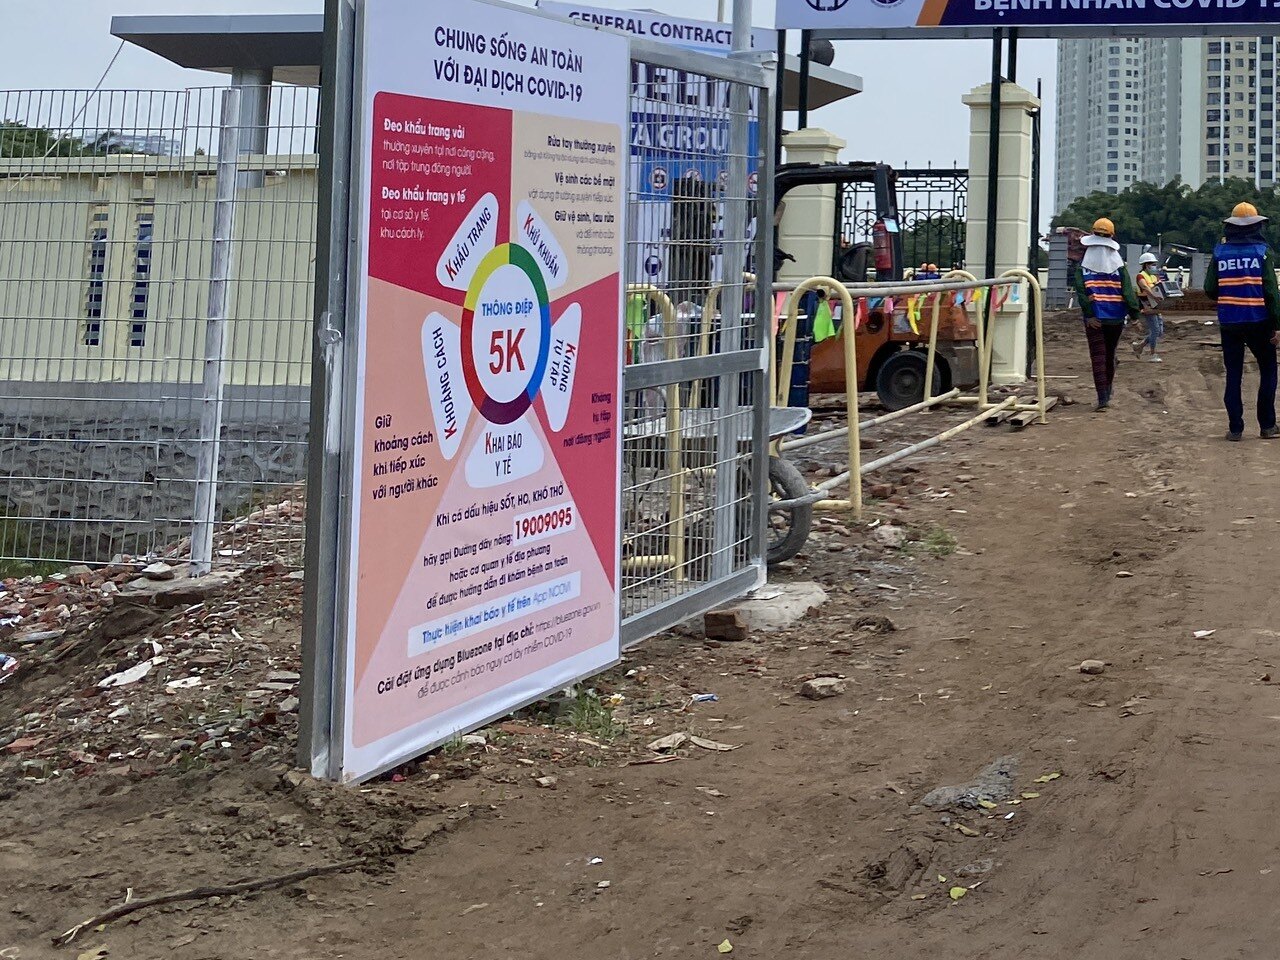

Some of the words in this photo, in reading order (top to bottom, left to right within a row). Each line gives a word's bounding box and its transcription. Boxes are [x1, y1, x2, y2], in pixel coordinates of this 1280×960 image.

[650, 22, 754, 48] CONTRACT
[435, 26, 486, 54] CHUNG
[490, 32, 526, 62] SỐNG
[531, 46, 547, 66] AN
[551, 49, 582, 73] TOÀN
[434, 56, 459, 82] VỚI
[464, 64, 487, 92] ĐẠI
[492, 70, 523, 95] DỊCH
[527, 76, 582, 102] COVID-19
[384, 118, 402, 132] Đeo
[405, 118, 426, 135] khẩu
[428, 123, 450, 140] trang
[452, 125, 464, 138] vải
[548, 135, 560, 147] Rửa
[562, 138, 573, 150] tay
[411, 162, 430, 175] trung
[555, 172, 563, 186] Vệ
[566, 174, 578, 184] sinh
[580, 175, 592, 185] các
[382, 187, 400, 200] Đeo
[403, 185, 424, 200] khẩu
[426, 189, 448, 205] trang
[451, 193, 455, 204] y
[457, 189, 466, 202] tế
[415, 211, 419, 221] y
[467, 207, 491, 246] TRANG
[555, 211, 566, 221] Giữ
[568, 211, 575, 224] vệ
[380, 227, 394, 238] khu
[396, 227, 415, 238] cách
[1218, 258, 1260, 271] DELTA
[482, 299, 512, 316] THÔNG
[515, 298, 533, 317] ĐIỆP
[433, 327, 447, 369] CÁCH
[490, 328, 525, 374] 5K
[559, 343, 576, 392] KHÔNG
[375, 414, 392, 429] Giữ
[375, 435, 408, 452] khoảng
[411, 431, 433, 446] cách
[485, 432, 504, 454] KHAI
[507, 432, 522, 450] BÁO
[373, 463, 387, 476] khi
[390, 456, 407, 473] tiếp
[409, 454, 425, 469] xúc
[495, 462, 500, 476] Y
[502, 453, 512, 474] TẾ
[373, 485, 386, 499] với
[389, 478, 414, 498] người
[416, 474, 438, 490] khác
[436, 513, 449, 527] Khi
[452, 508, 462, 522] có
[464, 503, 480, 520] dấu
[482, 502, 498, 516] hiệu
[500, 493, 516, 510] SỐT,
[518, 493, 531, 506] HO,
[533, 488, 548, 502] KHÓ
[550, 481, 564, 498] THỞ
[424, 554, 437, 566] hãy
[440, 551, 451, 565] gọi
[516, 507, 571, 539] 19009095
[450, 568, 468, 582] hoặc
[470, 565, 480, 575] cơ
[481, 562, 499, 575] quan
[506, 551, 515, 564] tế
[423, 628, 442, 644] Thực
[464, 612, 482, 628] khai
[484, 604, 499, 622] báo
[501, 606, 506, 618] y
[508, 598, 516, 613] tế
[397, 670, 412, 688] đặt
[414, 665, 431, 679] ứng
[434, 656, 455, 673] dụng
[457, 642, 492, 663] Bluezone
[495, 634, 504, 650] tại
[507, 630, 519, 645] địa
